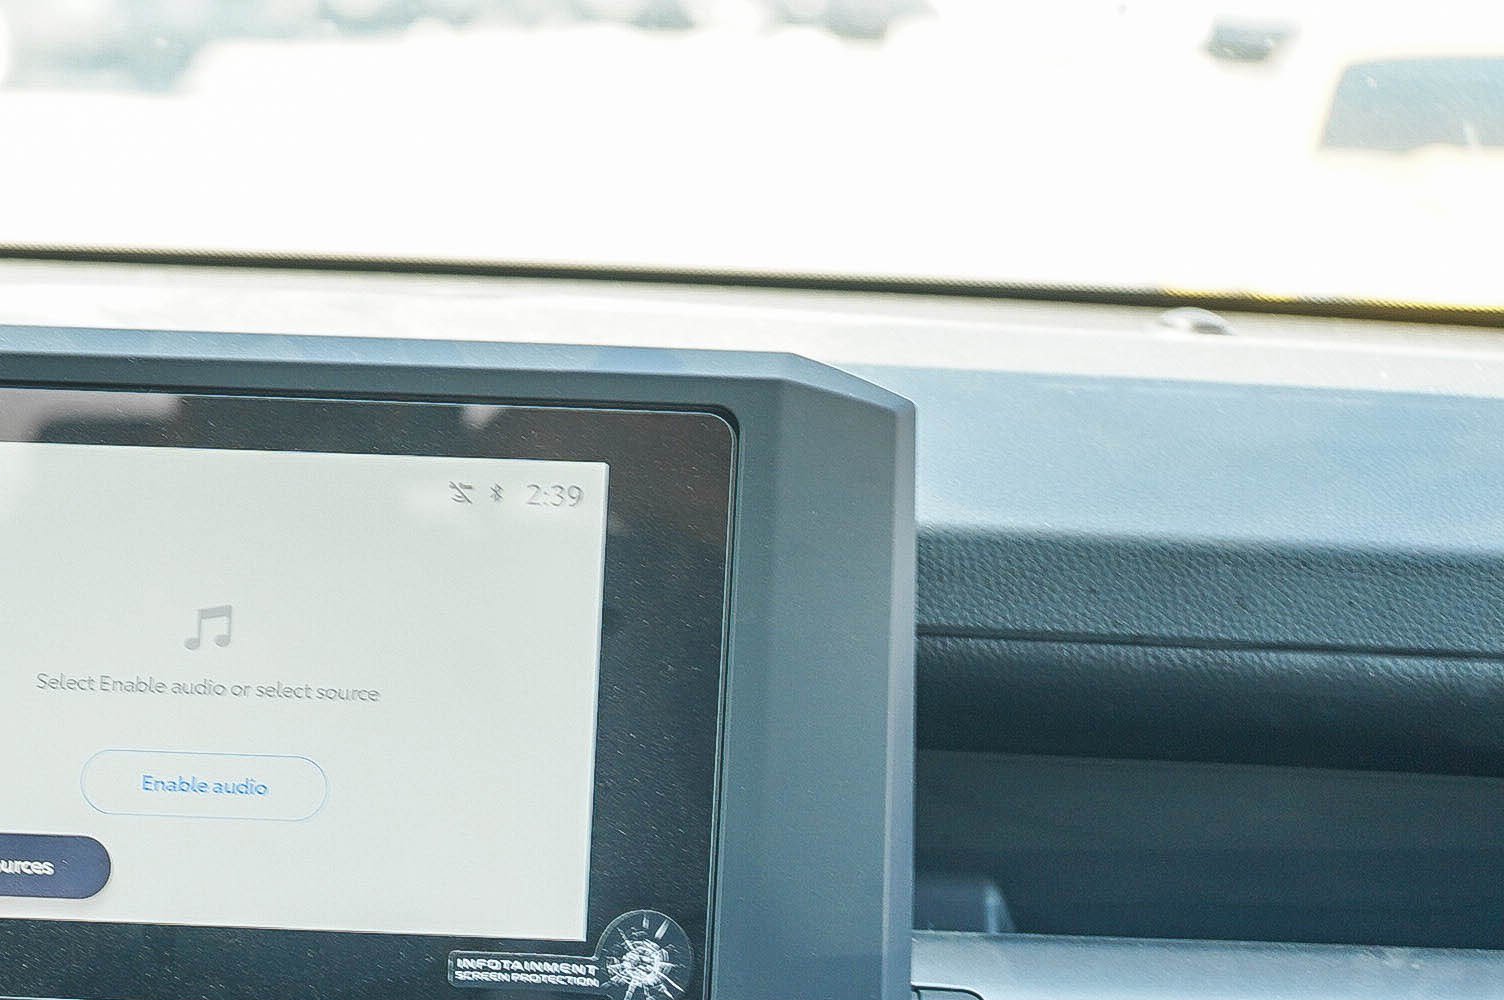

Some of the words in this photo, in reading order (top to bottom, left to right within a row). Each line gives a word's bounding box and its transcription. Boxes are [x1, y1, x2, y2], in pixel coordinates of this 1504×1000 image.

[525, 483, 585, 507] 2:39
[36, 672, 96, 692] Select
[99, 674, 167, 694] Enable
[171, 678, 227, 697] audio
[230, 682, 251, 698] or
[255, 680, 312, 699] select
[317, 686, 382, 702] source
[141, 774, 209, 795] Enable
[212, 776, 269, 796] audio
[456, 957, 599, 976] INFOTAINMENT
[454, 970, 511, 983] SCREEN
[511, 972, 600, 988] PROTECTION
